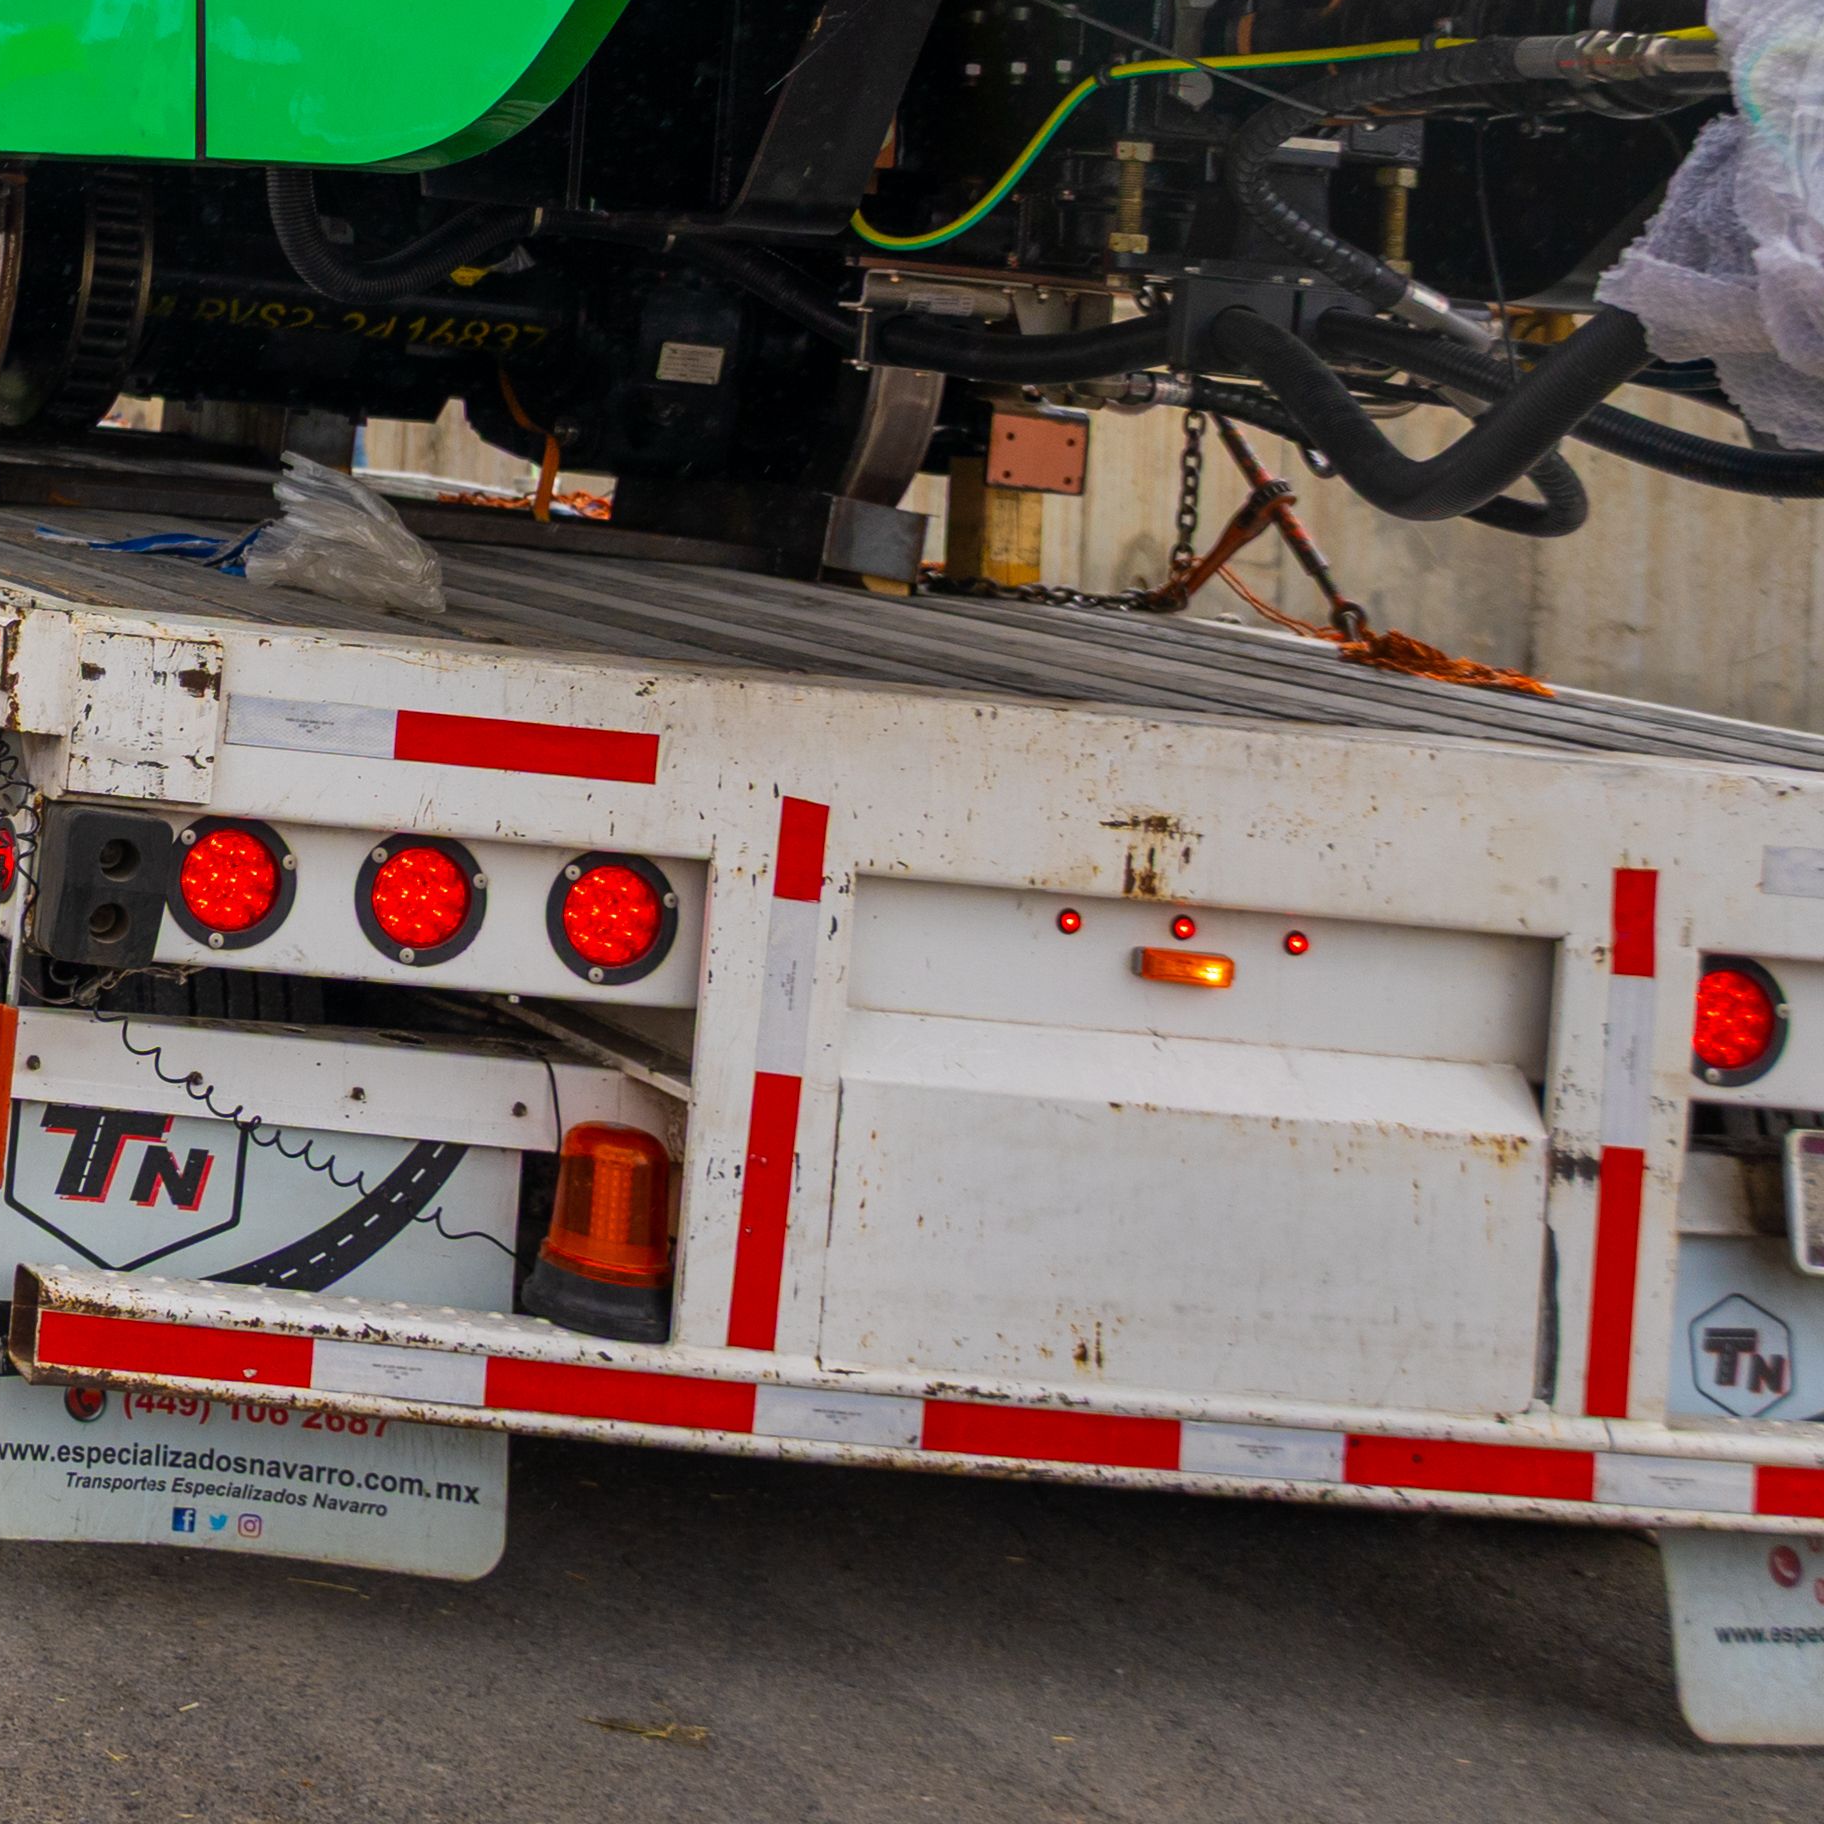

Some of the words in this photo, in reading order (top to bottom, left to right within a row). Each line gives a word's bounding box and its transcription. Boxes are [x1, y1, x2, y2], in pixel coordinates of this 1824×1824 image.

[40, 1102, 214, 1212] TN
[1703, 1327, 1788, 1395] TN
[65, 1471, 167, 1494] Transportes
[170, 1477, 309, 1508] Especializados
[312, 1492, 388, 1518] Navarro
